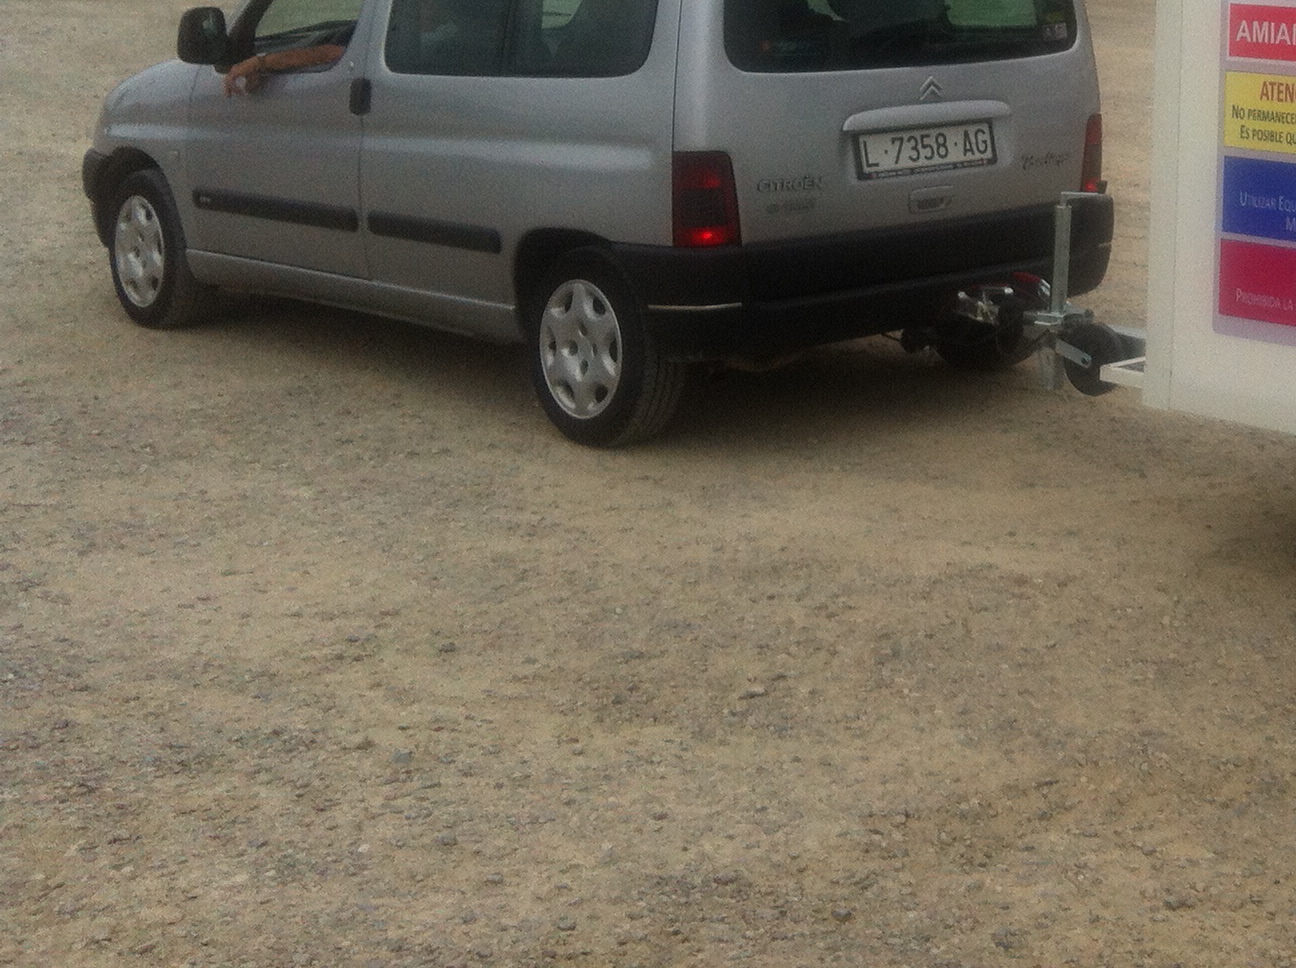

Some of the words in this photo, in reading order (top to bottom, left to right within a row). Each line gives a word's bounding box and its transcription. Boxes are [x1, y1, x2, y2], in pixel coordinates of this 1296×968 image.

[1231, 105, 1246, 120] NO
[1240, 125, 1250, 140] ES
[1252, 128, 1284, 144] POSIBLE
